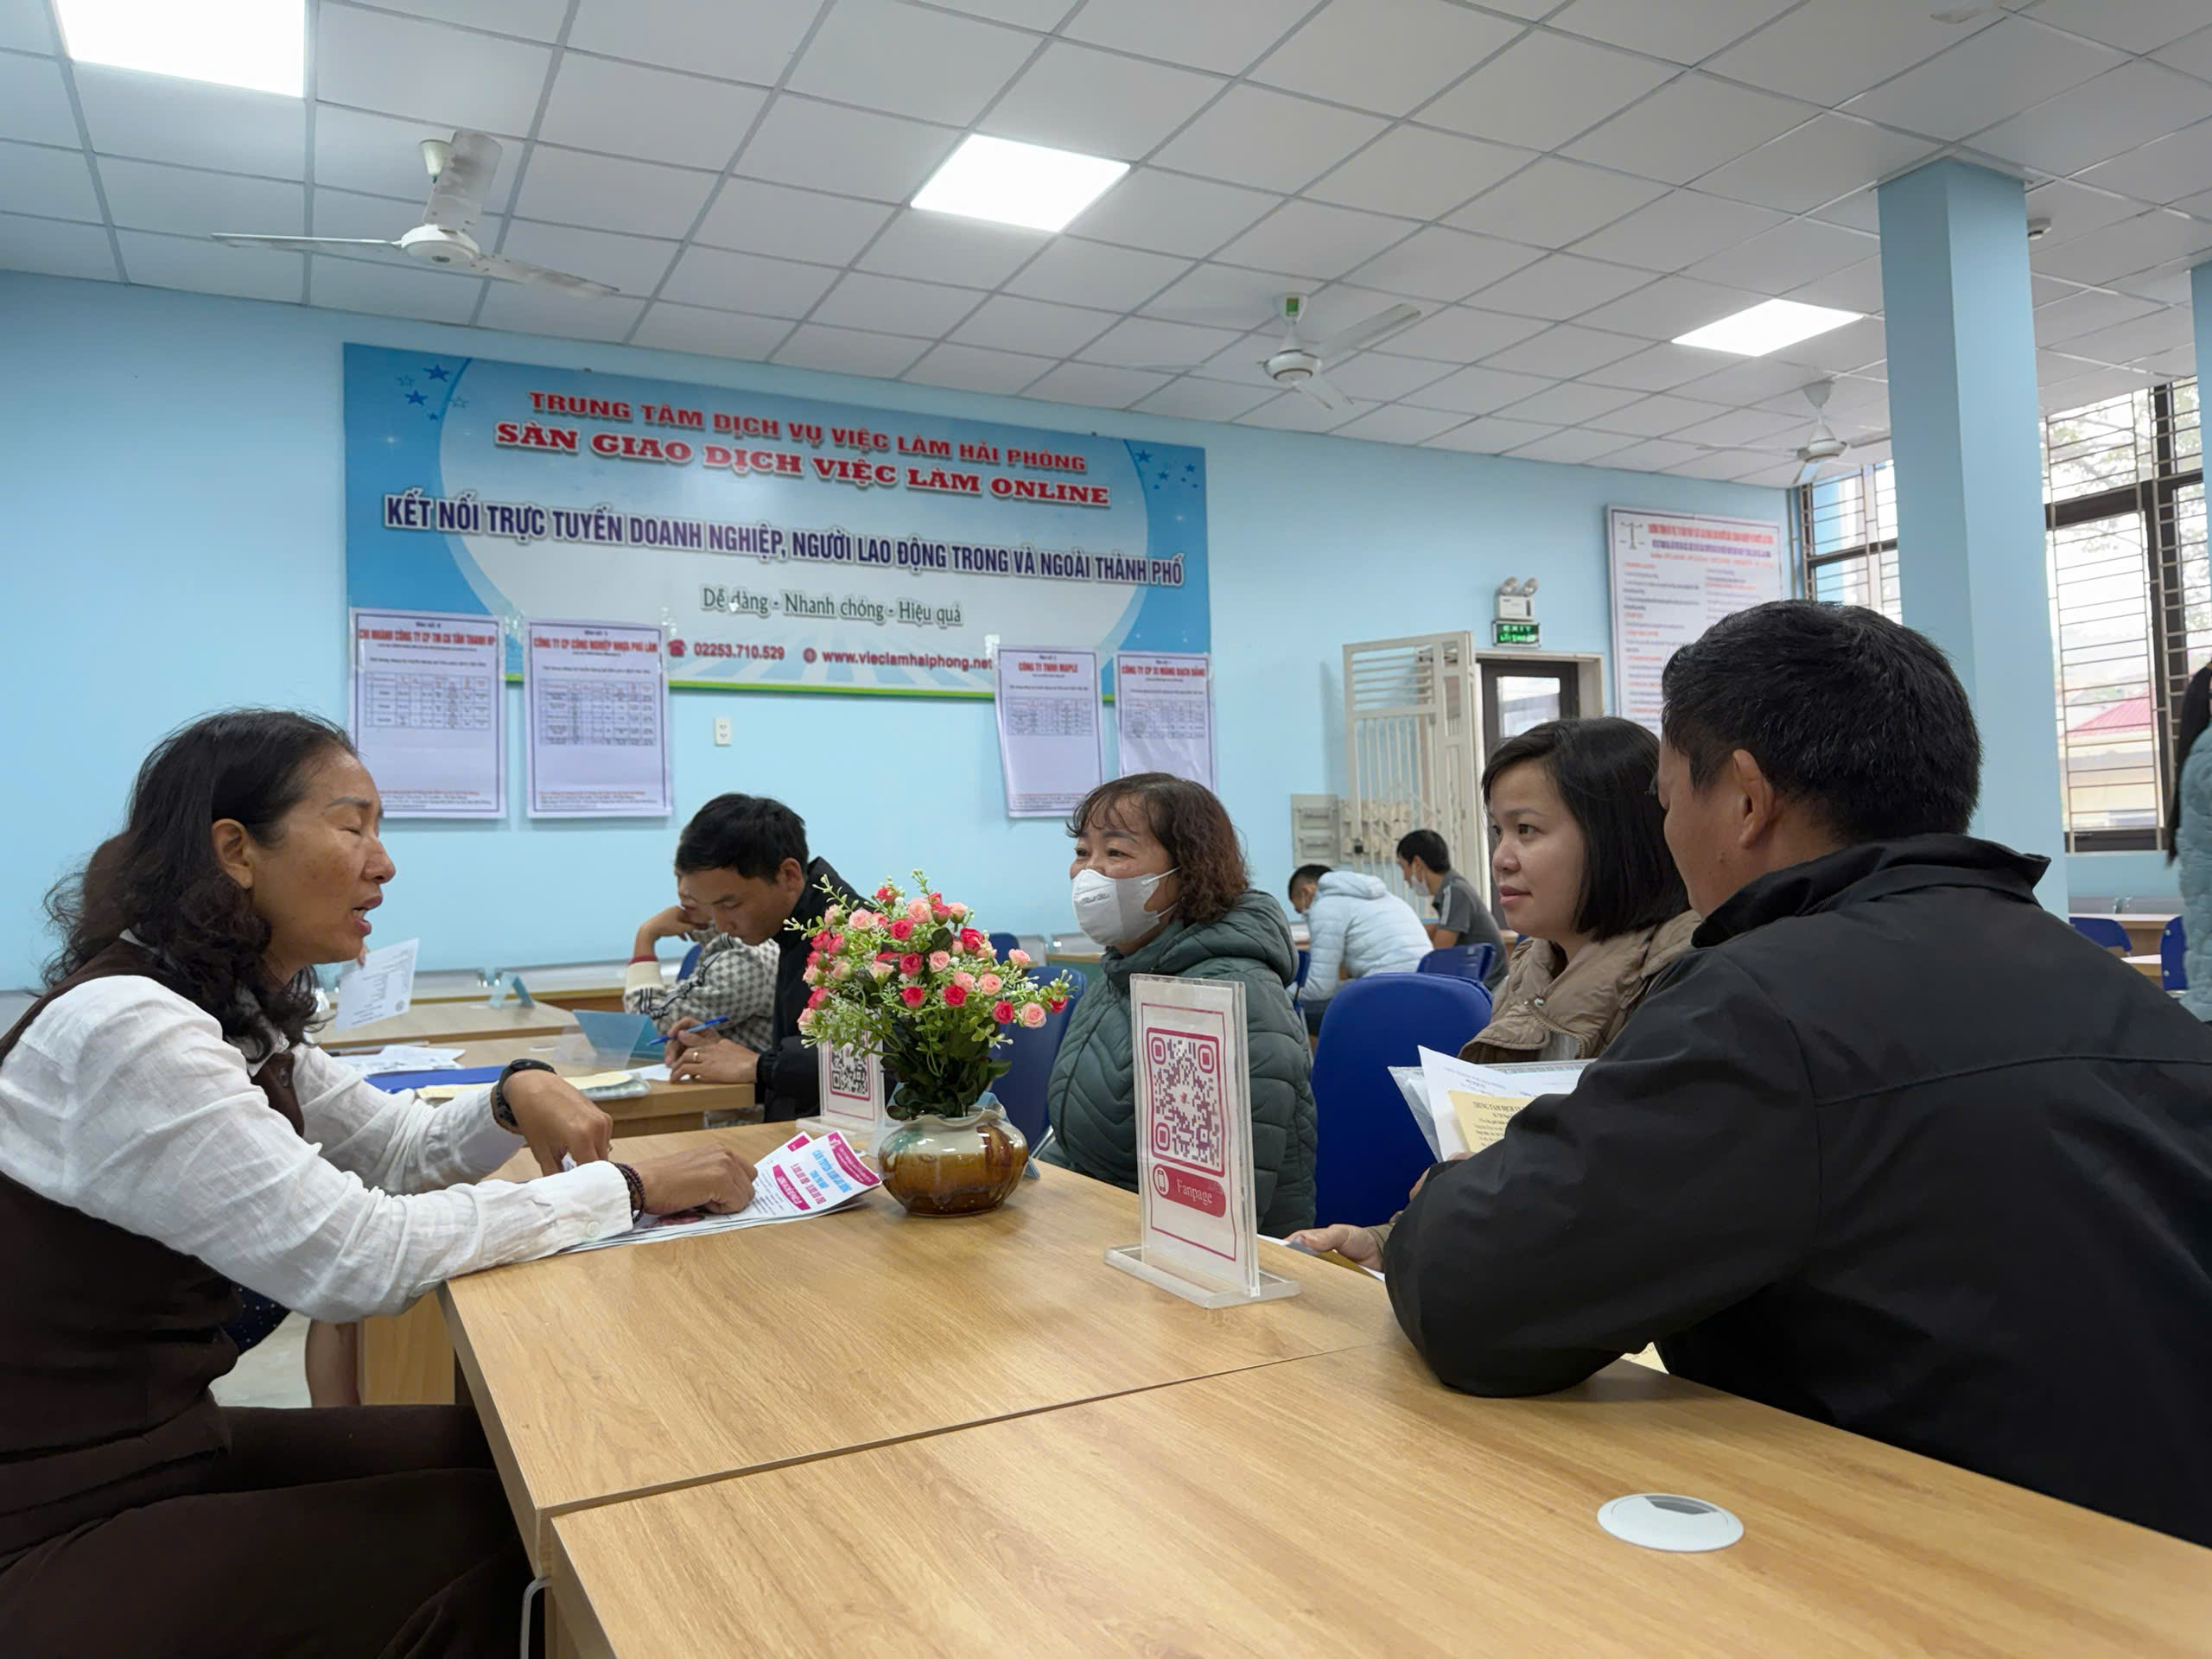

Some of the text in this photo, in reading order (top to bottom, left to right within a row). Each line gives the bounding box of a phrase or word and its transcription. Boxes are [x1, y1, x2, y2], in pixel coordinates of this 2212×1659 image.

[530, 391, 1085, 471] TRUNG TÂM DỊCH VỤ VIỆC LÀM HẢI PHÒNG
[498, 421, 1109, 504] SÀN GIAO DỊCH VIỆC LÀM ONLINE
[387, 490, 1181, 584] KẾT NỐI TRỰC TUYẾN DOANH NGHIỆP, NGƯỜI LAO ĐỘNG TRONG VÀ NGOÀI THÀNH PHỐ
[704, 588, 723, 608] Dễ
[731, 592, 768, 614] dàng
[785, 594, 835, 615] Nhanh
[841, 599, 884, 620] chóng
[899, 601, 931, 623] Hiệu
[937, 606, 960, 625] quả
[694, 642, 993, 671] 02253.710.529 www.vieclamhaiphong.net
[1177, 1179, 1212, 1205] Fanpage
